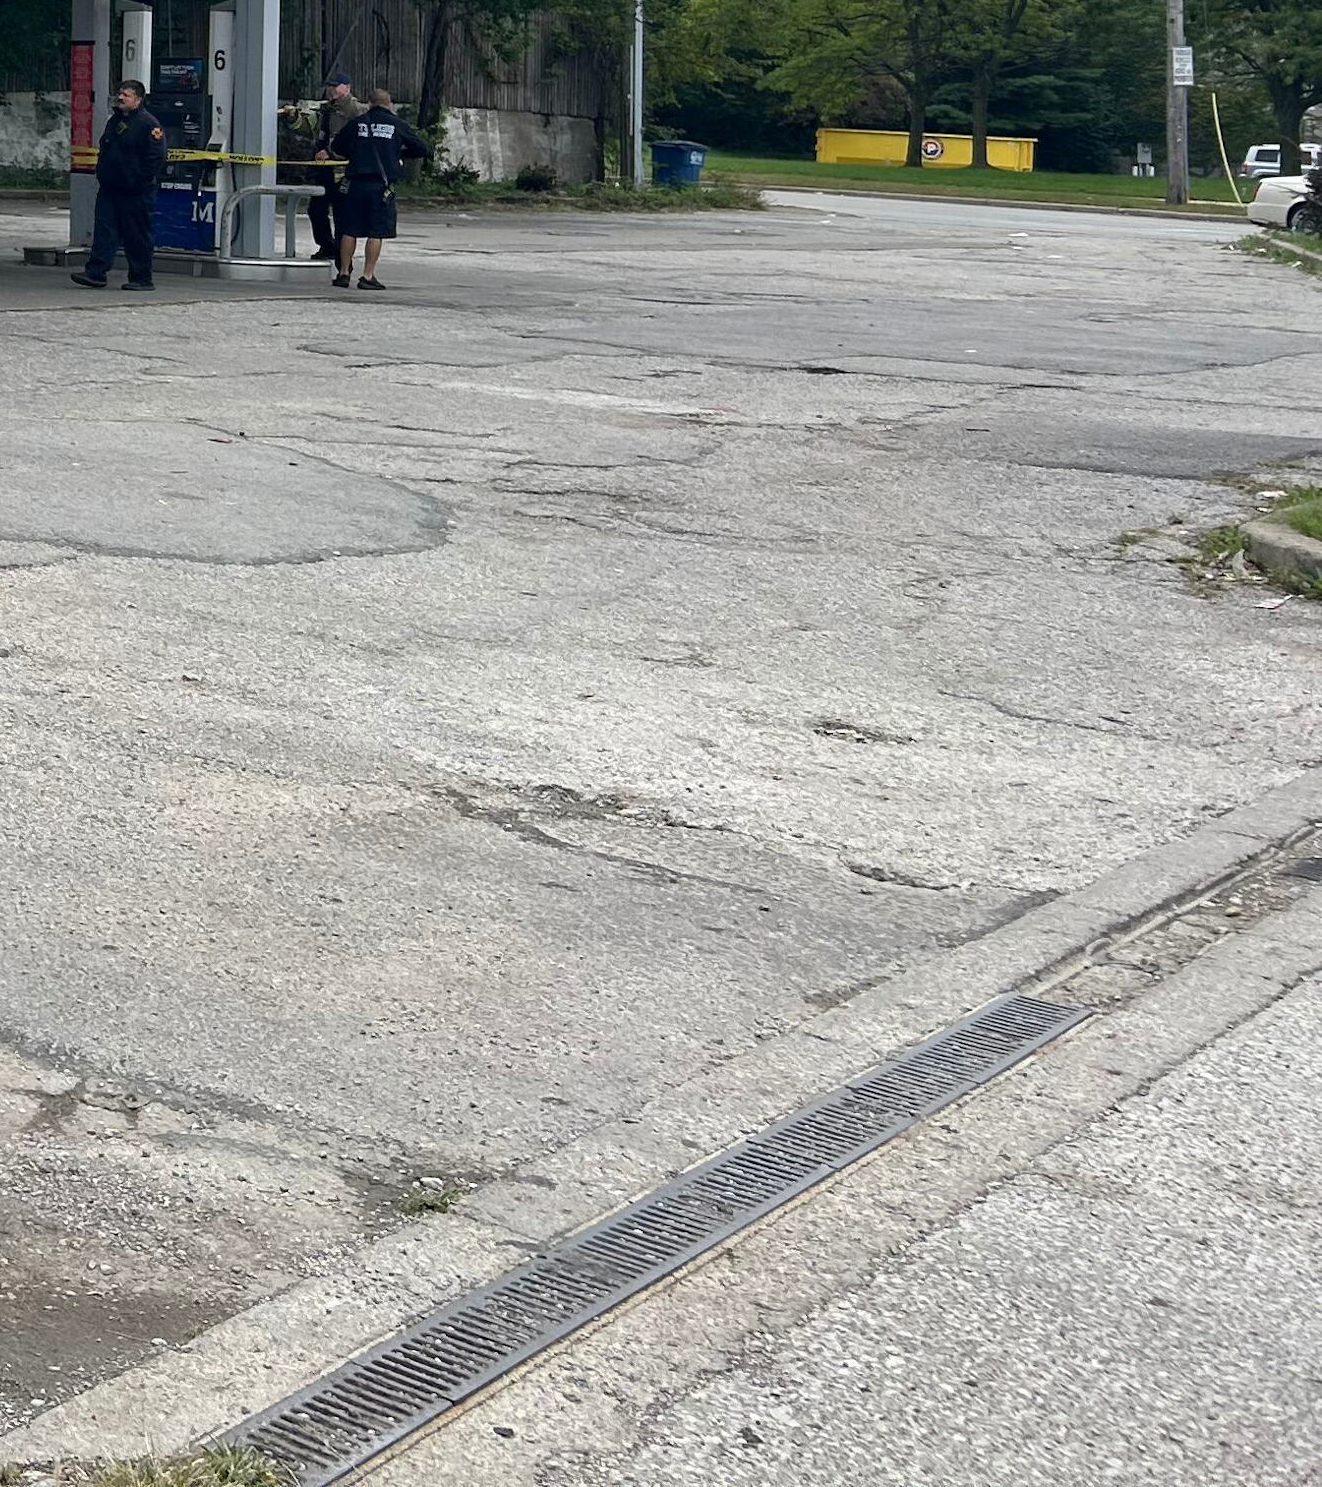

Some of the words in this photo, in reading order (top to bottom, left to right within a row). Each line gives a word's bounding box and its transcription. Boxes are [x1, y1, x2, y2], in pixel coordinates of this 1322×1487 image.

[126, 39, 135, 61] 6
[214, 50, 225, 70] 6
[191, 201, 214, 222] M
